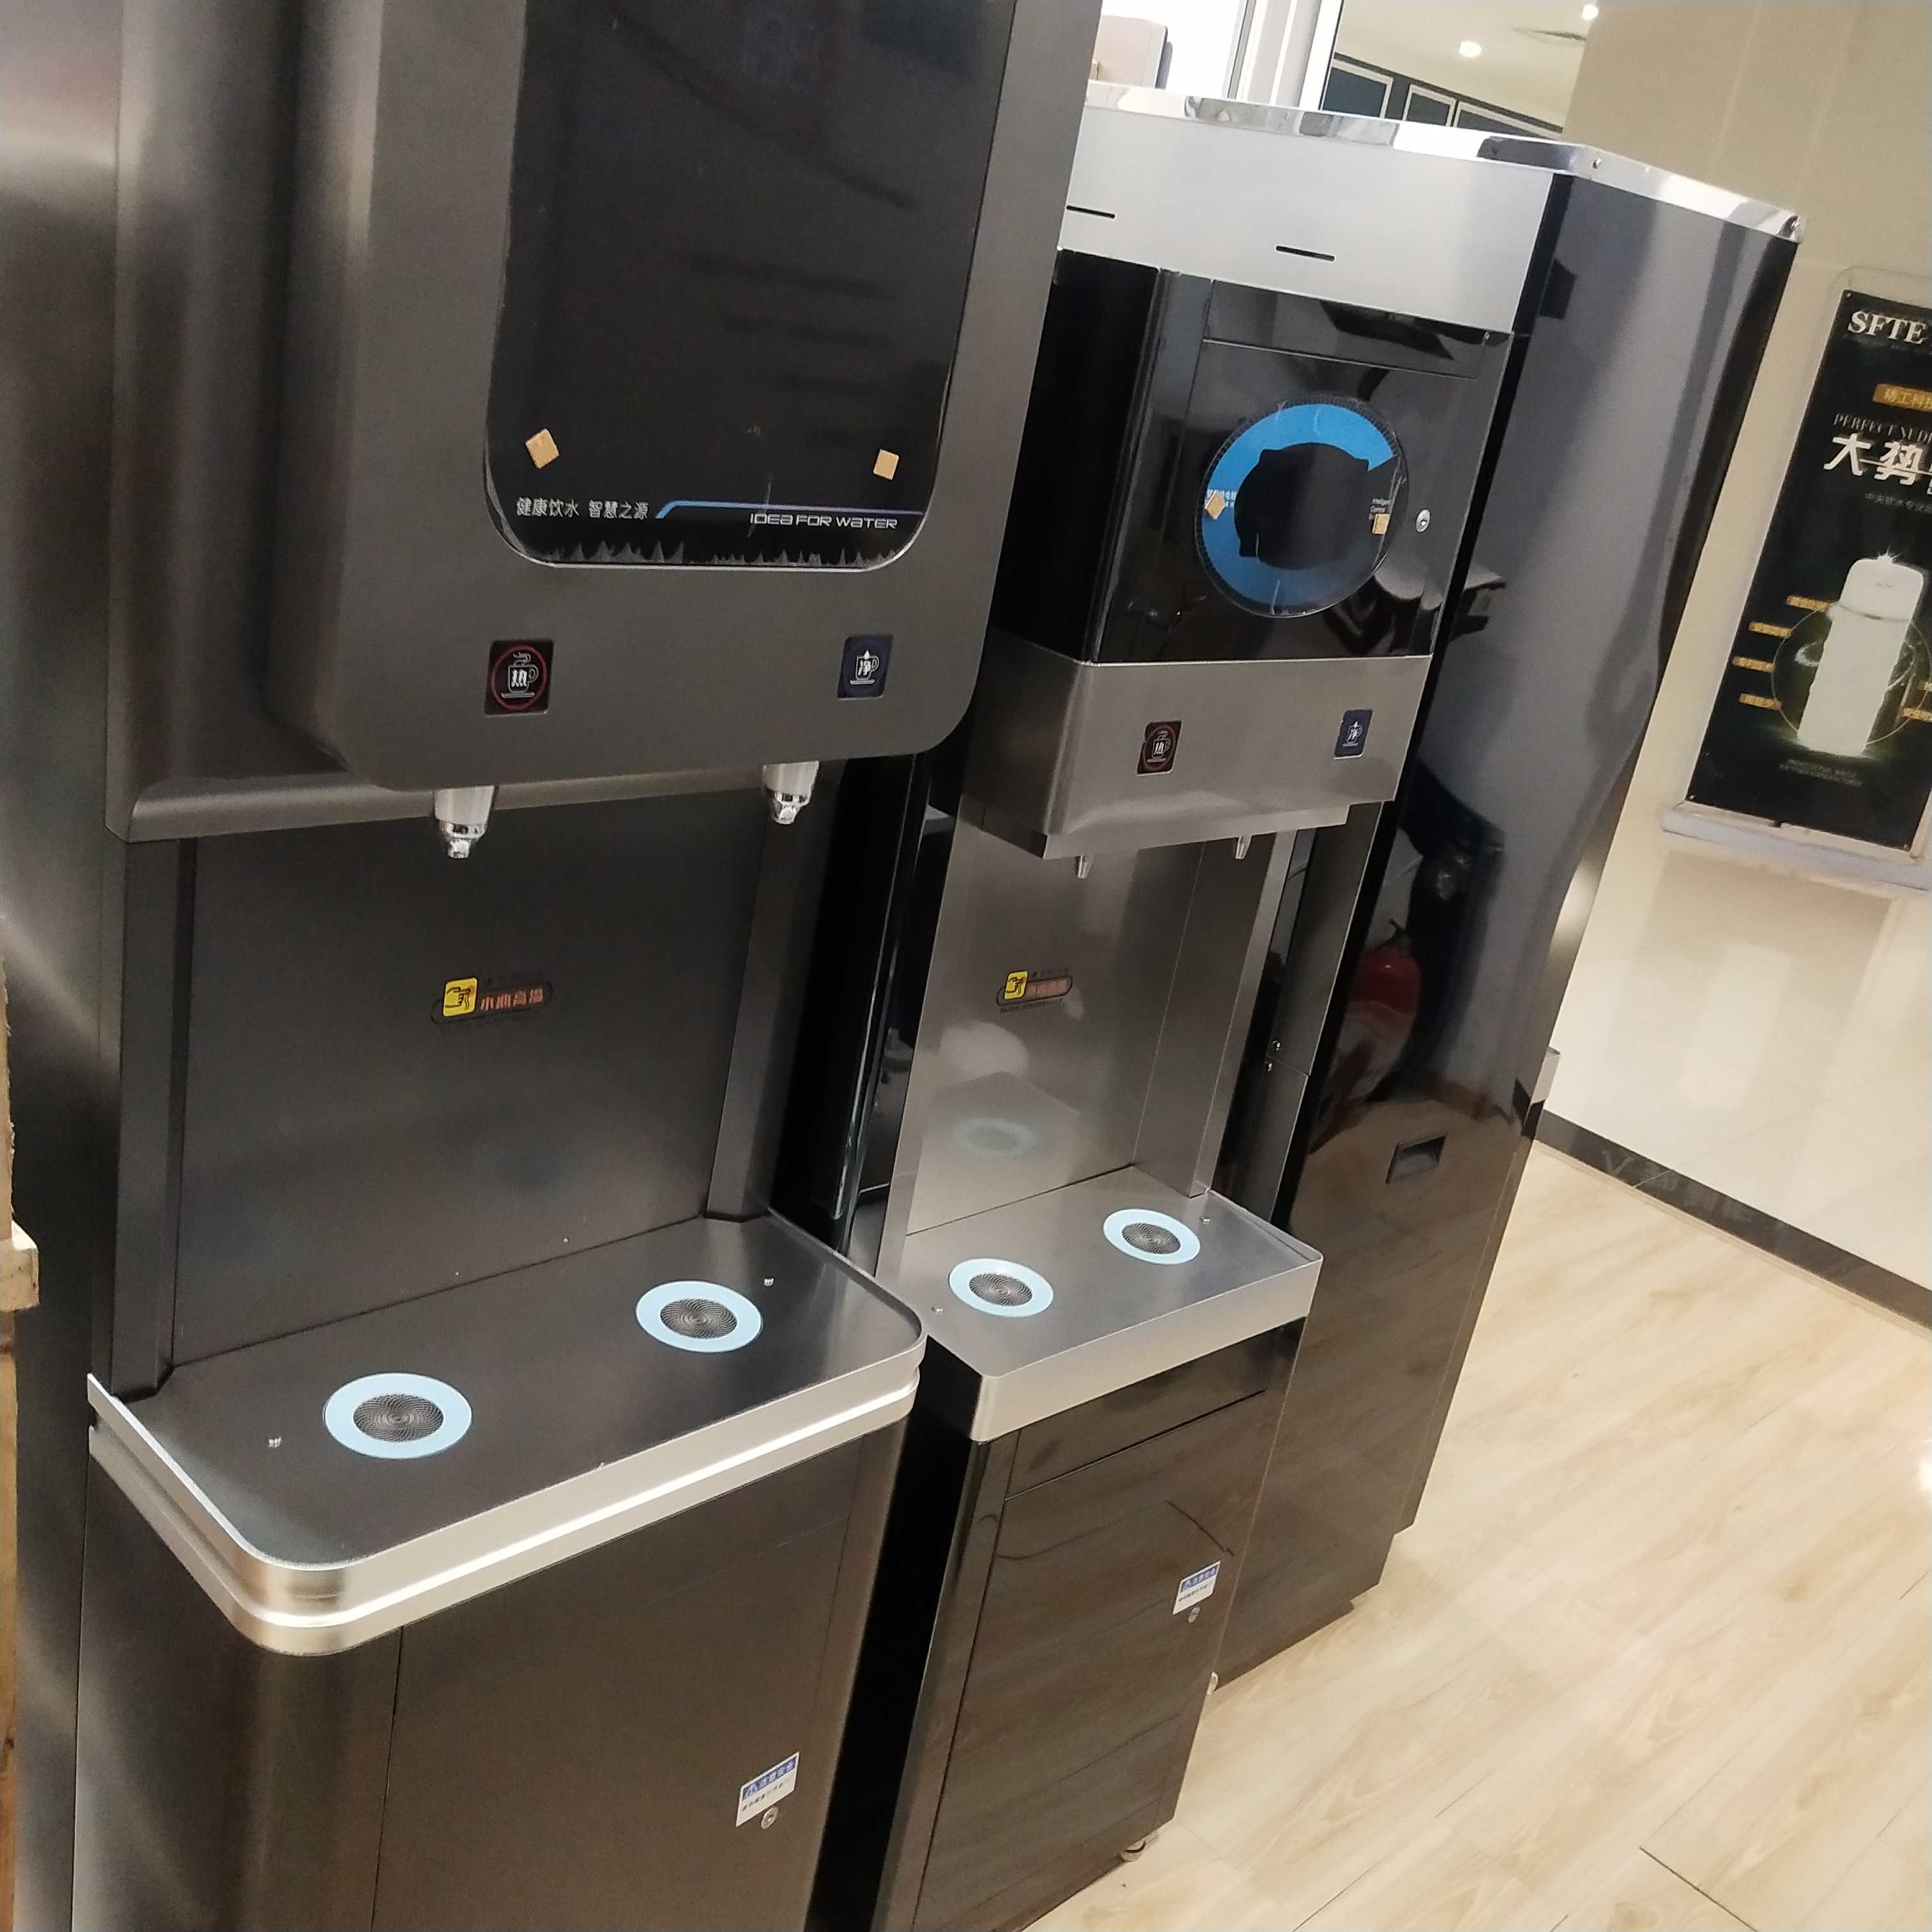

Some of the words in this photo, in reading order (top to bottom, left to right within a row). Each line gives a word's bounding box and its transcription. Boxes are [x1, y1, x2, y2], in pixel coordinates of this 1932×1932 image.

[516, 496, 579, 518] 健康饮水
[588, 499, 648, 520] 智慧之源
[795, 514, 832, 527] FOR
